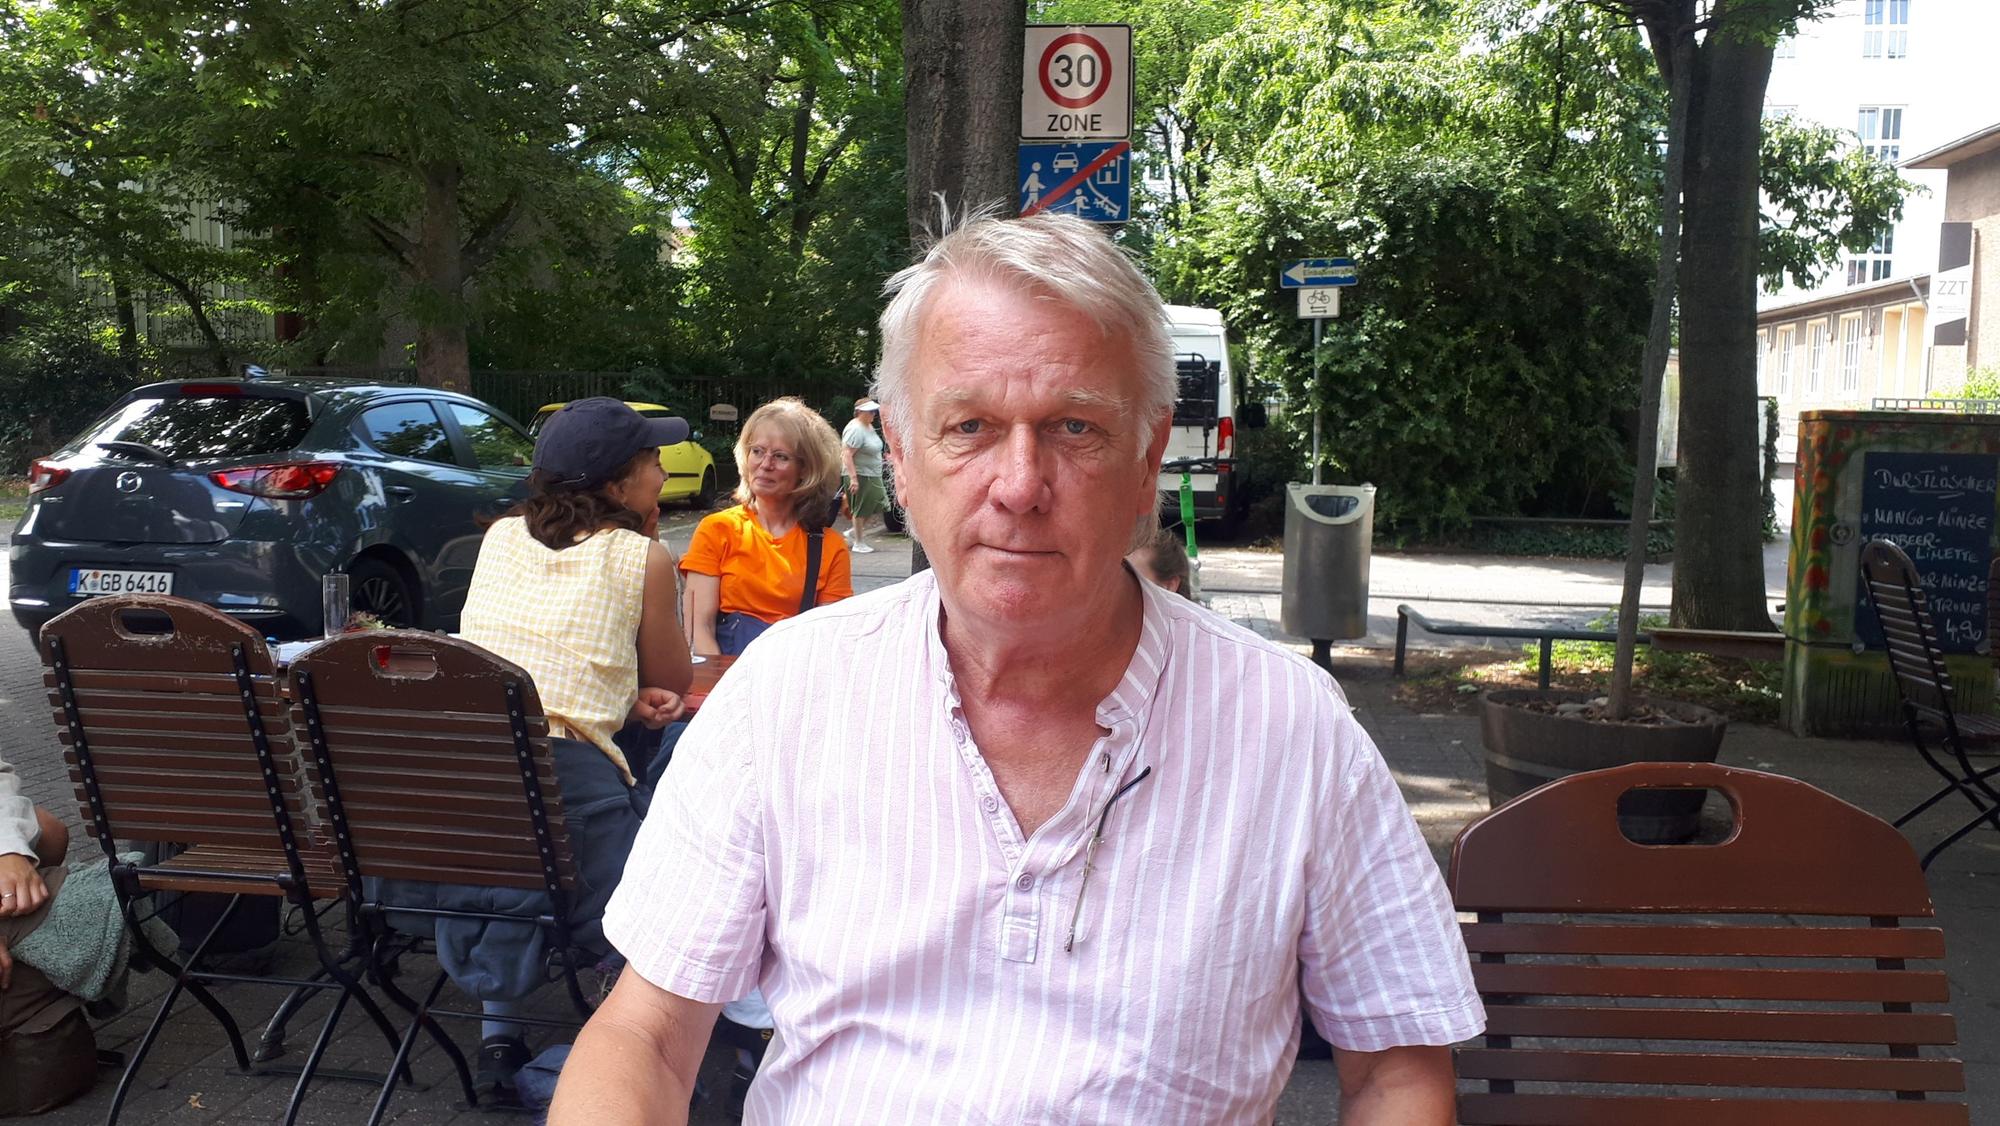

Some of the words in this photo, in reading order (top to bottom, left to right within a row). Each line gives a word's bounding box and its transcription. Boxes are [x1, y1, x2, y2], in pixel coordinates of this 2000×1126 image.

[1054, 54, 1096, 88] 30
[1047, 114, 1102, 132] ZONE
[1937, 280, 1968, 295] ZZT
[1915, 547, 1978, 563] LIMETTE
[78, 572, 90, 591] K
[100, 574, 122, 592] GB
[125, 574, 167, 592] 6416
[1920, 571, 1986, 592] ER-MINZE
[1928, 595, 1981, 616] ITRONE
[1946, 618, 1982, 643] 4,90
